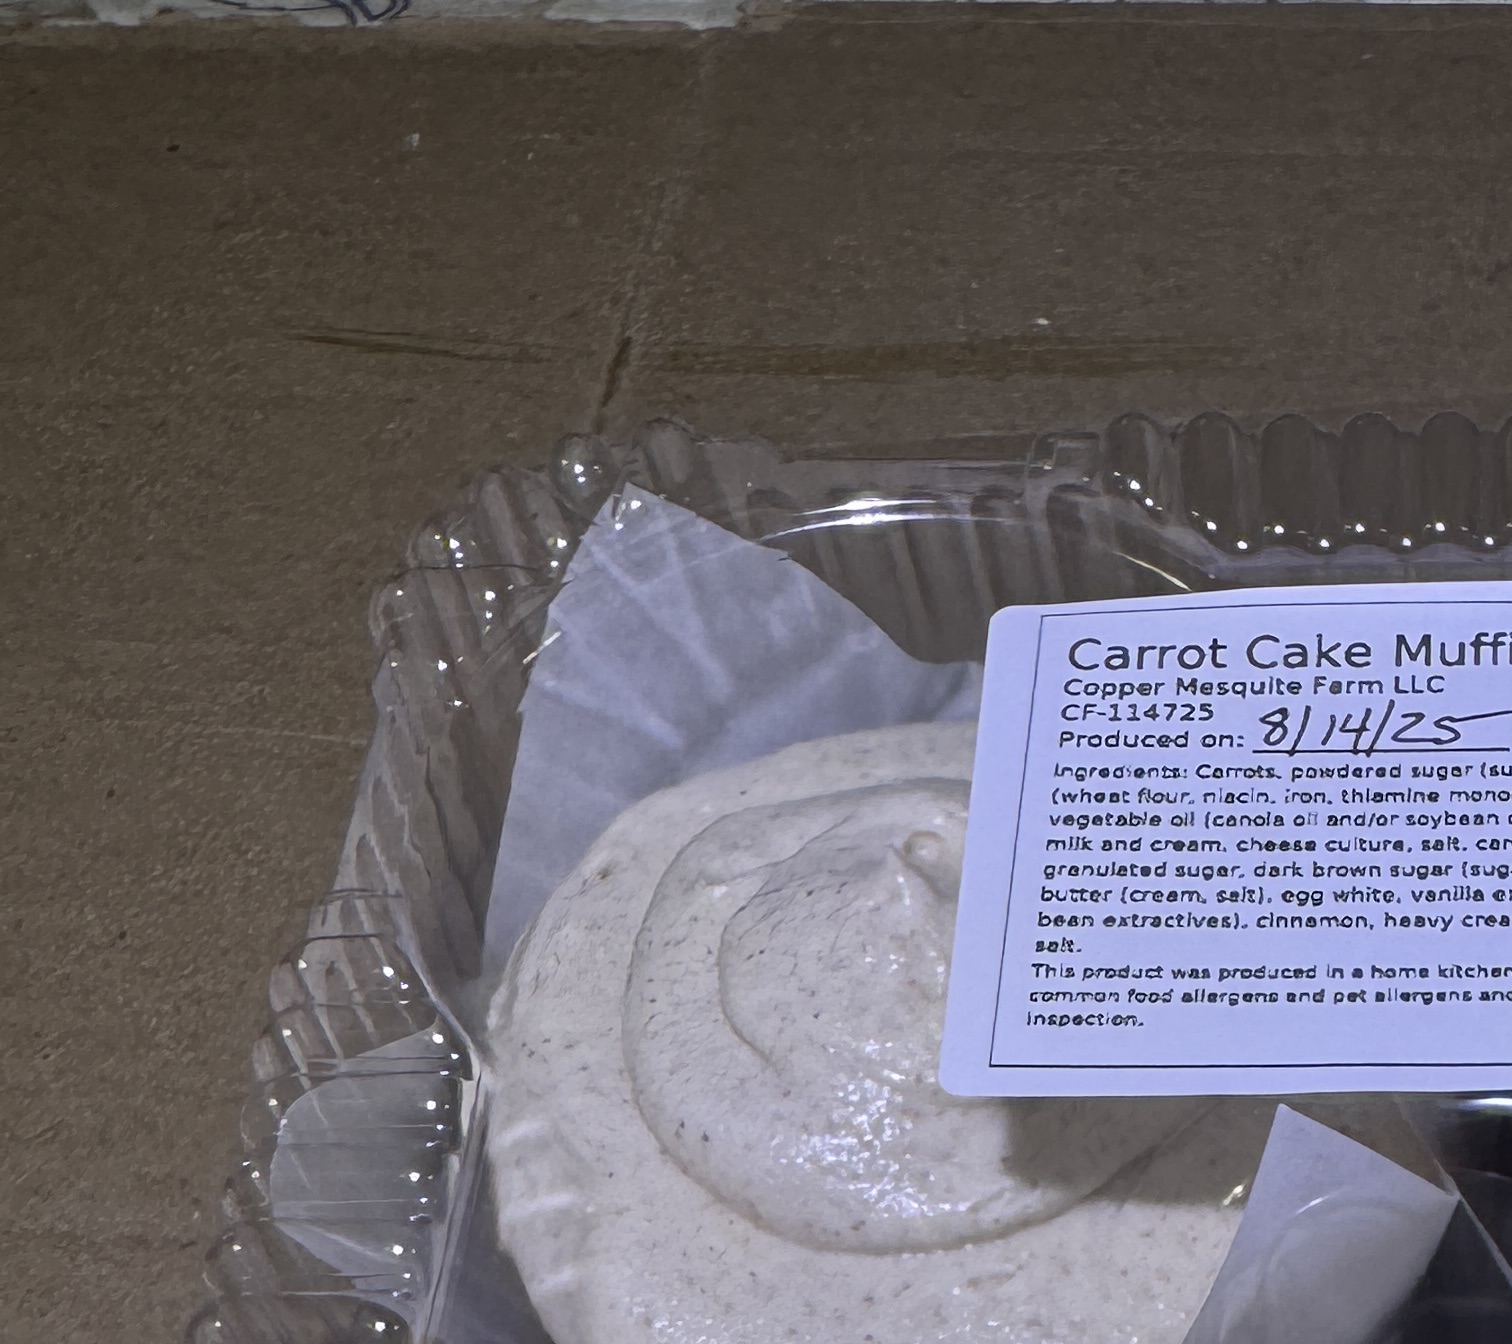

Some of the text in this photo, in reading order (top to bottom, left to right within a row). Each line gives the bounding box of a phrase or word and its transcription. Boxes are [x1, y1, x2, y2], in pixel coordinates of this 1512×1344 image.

[1067, 637, 1228, 672] Carrot
[1245, 632, 1372, 670] Cake
[1063, 674, 1446, 701] Copper Mesquite Farm LLC
[1060, 702, 1215, 723] CF-114725
[1058, 729, 1245, 749] Produced on:
[1053, 762, 1189, 783] Ingredients:
[1290, 763, 1402, 784] powdered
[1410, 764, 1474, 782] sugar
[1051, 787, 1131, 806] (wheat
[1340, 786, 1441, 805] thiamine
[1048, 810, 1163, 831] vegetable
[1170, 810, 1196, 828] oil
[1203, 810, 1286, 830] (canola
[1292, 811, 1319, 828] oil
[1325, 811, 1400, 829] and/or
[1404, 809, 1500, 831] soybean
[1045, 835, 1094, 852] milk
[1100, 836, 1143, 853] and
[1235, 836, 1317, 853] cheese
[1042, 860, 1168, 881] granulated
[1253, 860, 1305, 878] dark
[1312, 860, 1382, 879] brown
[1389, 864, 1454, 881] sugar
[1040, 884, 1114, 904] butter
[1280, 889, 1324, 908] egg
[1410, 884, 1485, 904] vanilla
[1037, 910, 1095, 928] bean
[1383, 911, 1454, 933] heavy
[1030, 962, 1076, 980] This
[1081, 964, 1165, 982] product
[1170, 967, 1212, 980] was
[1217, 964, 1318, 983] produced
[1326, 963, 1345, 980] in
[1350, 967, 1364, 980] a
[1370, 964, 1430, 980] home
[1029, 990, 1120, 1004] common
[1127, 987, 1175, 1004] food
[1180, 988, 1279, 1007] allergens
[1286, 987, 1326, 1004] and
[1333, 988, 1367, 1006] pet
[1374, 987, 1473, 1006] allergens
